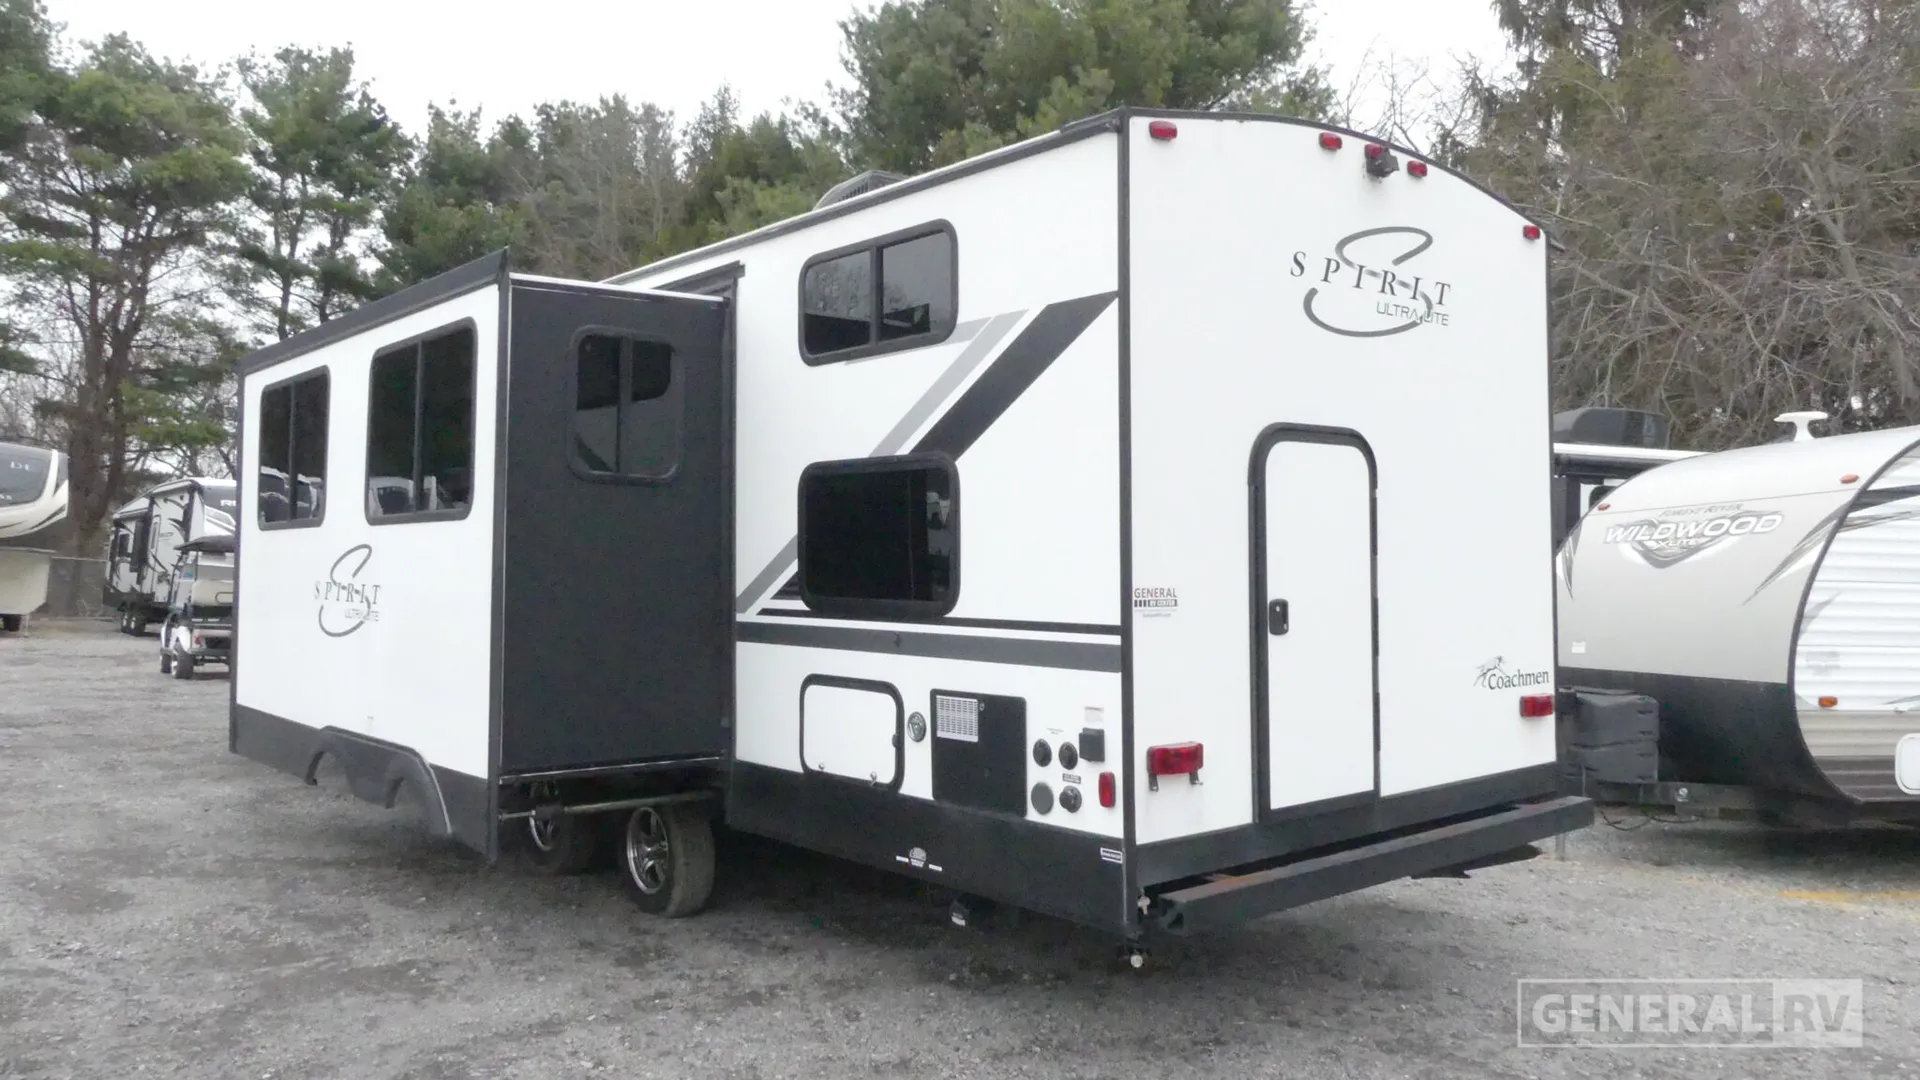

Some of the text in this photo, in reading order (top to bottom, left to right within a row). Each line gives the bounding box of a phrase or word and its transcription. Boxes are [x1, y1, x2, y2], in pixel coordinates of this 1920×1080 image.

[1290, 251, 1451, 306] SPIRIT
[1604, 511, 1786, 544] WILDWOOD
[313, 580, 382, 605] SPIRIT
[1133, 587, 1178, 599] GENERAL
[1487, 668, 1550, 690] Coachmen
